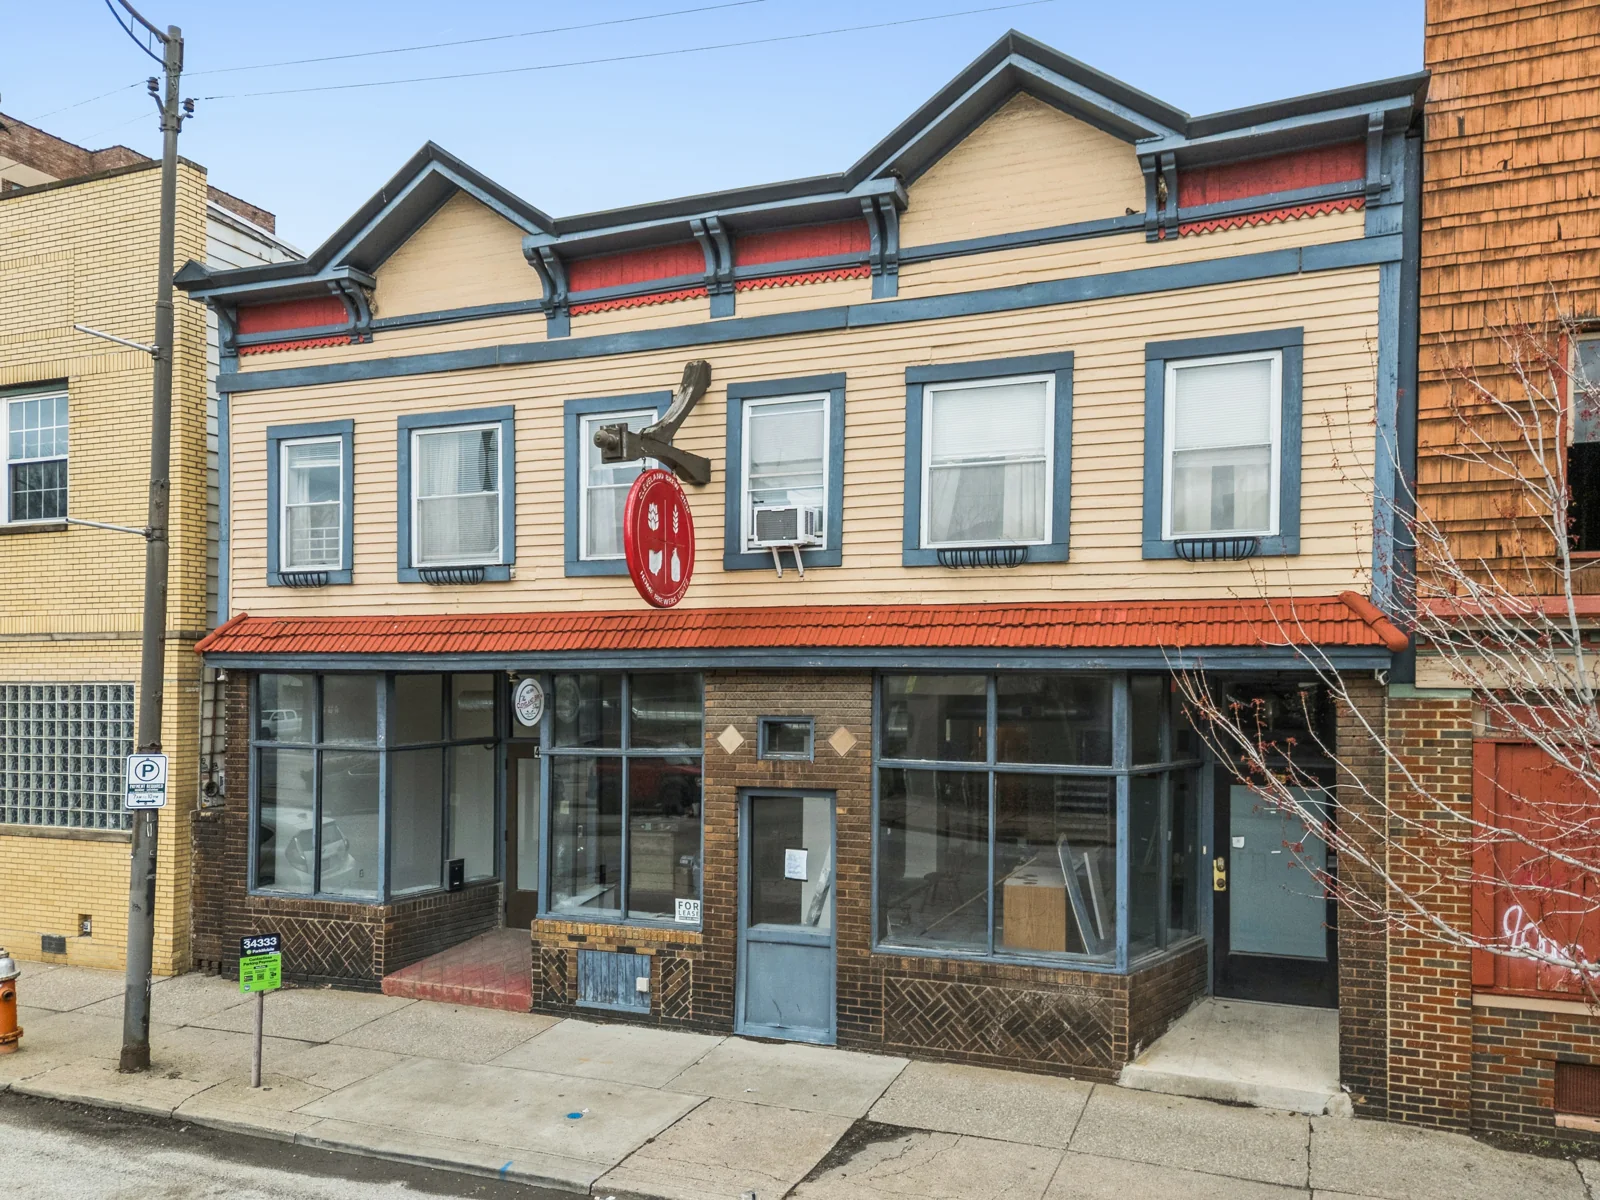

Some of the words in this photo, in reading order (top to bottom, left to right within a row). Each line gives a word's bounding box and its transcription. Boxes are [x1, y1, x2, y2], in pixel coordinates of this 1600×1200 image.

[638, 473, 664, 499] CLEVELAND
[665, 474, 680, 490] BREW
[640, 570, 654, 594] HOME
[653, 593, 677, 605] BREWERS
[142, 764, 155, 778] P
[678, 901, 699, 911] FOR
[243, 937, 278, 949] 34333
